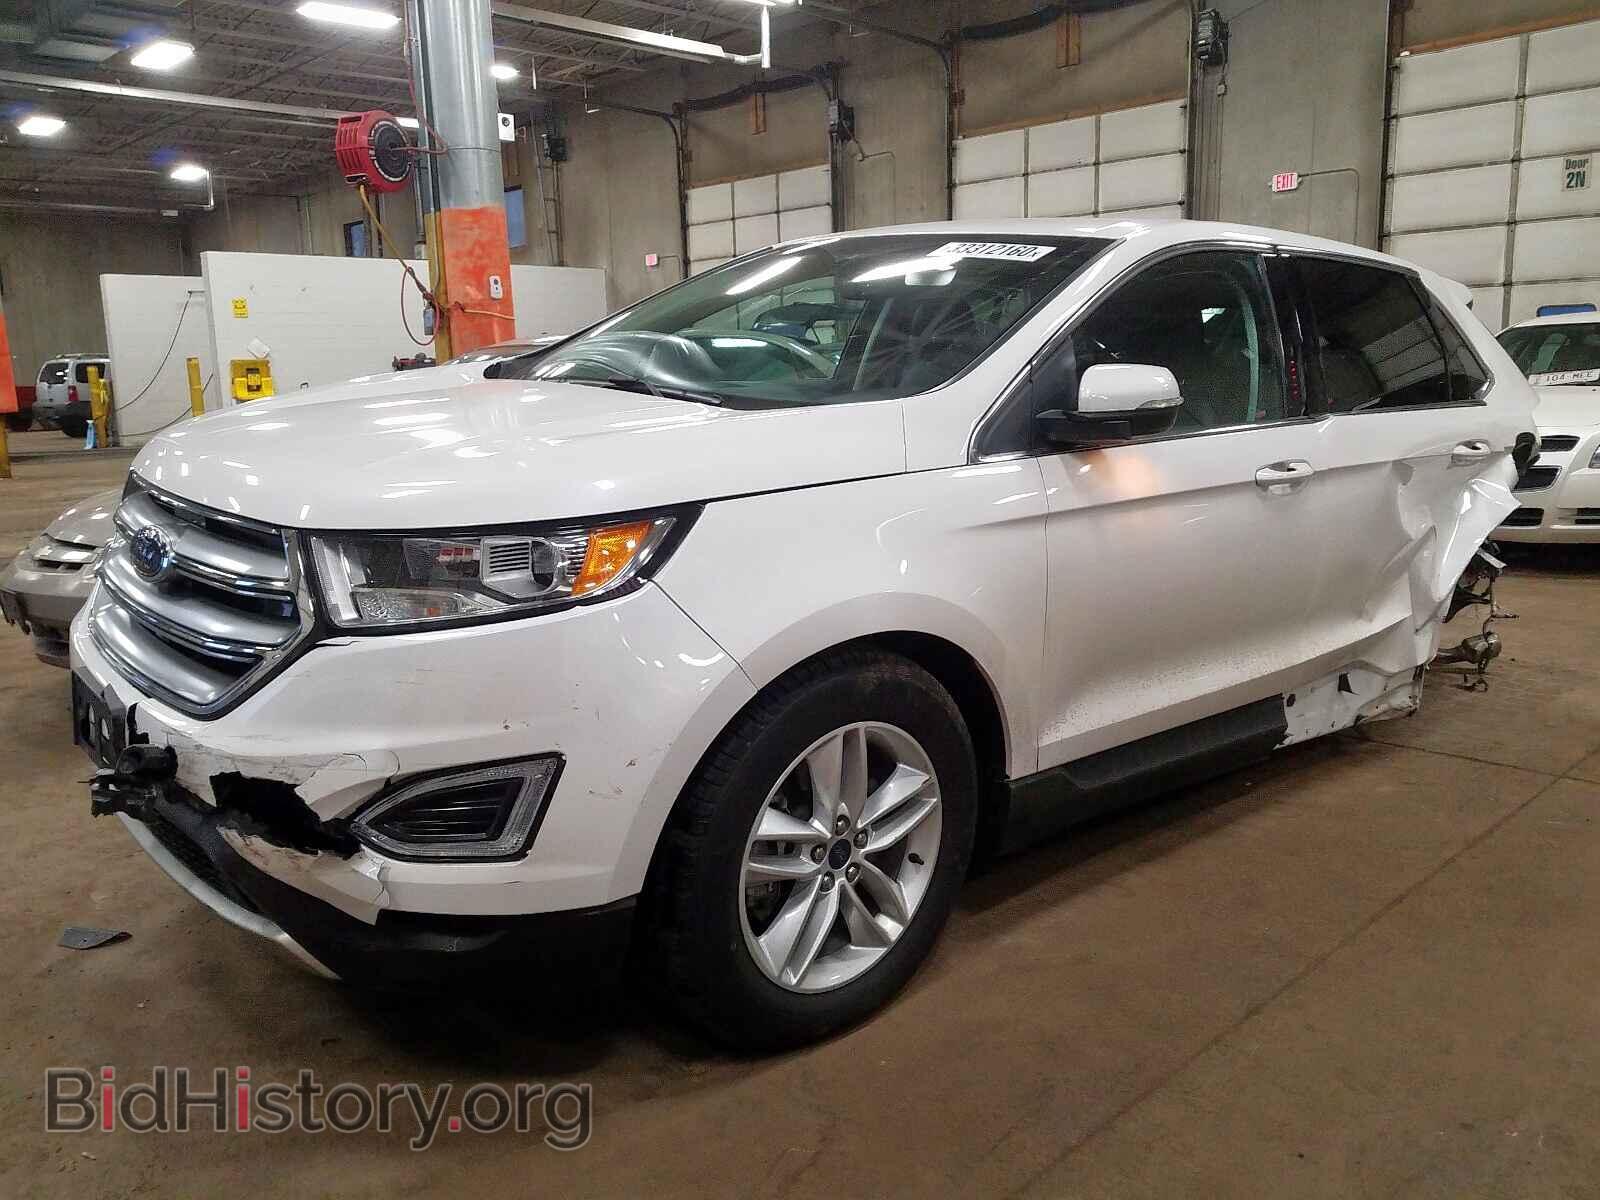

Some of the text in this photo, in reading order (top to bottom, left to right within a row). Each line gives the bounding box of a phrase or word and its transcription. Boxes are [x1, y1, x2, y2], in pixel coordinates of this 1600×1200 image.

[1565, 158, 1589, 170] Door
[1276, 174, 1295, 190] EXIT
[1566, 170, 1586, 189] 2N
